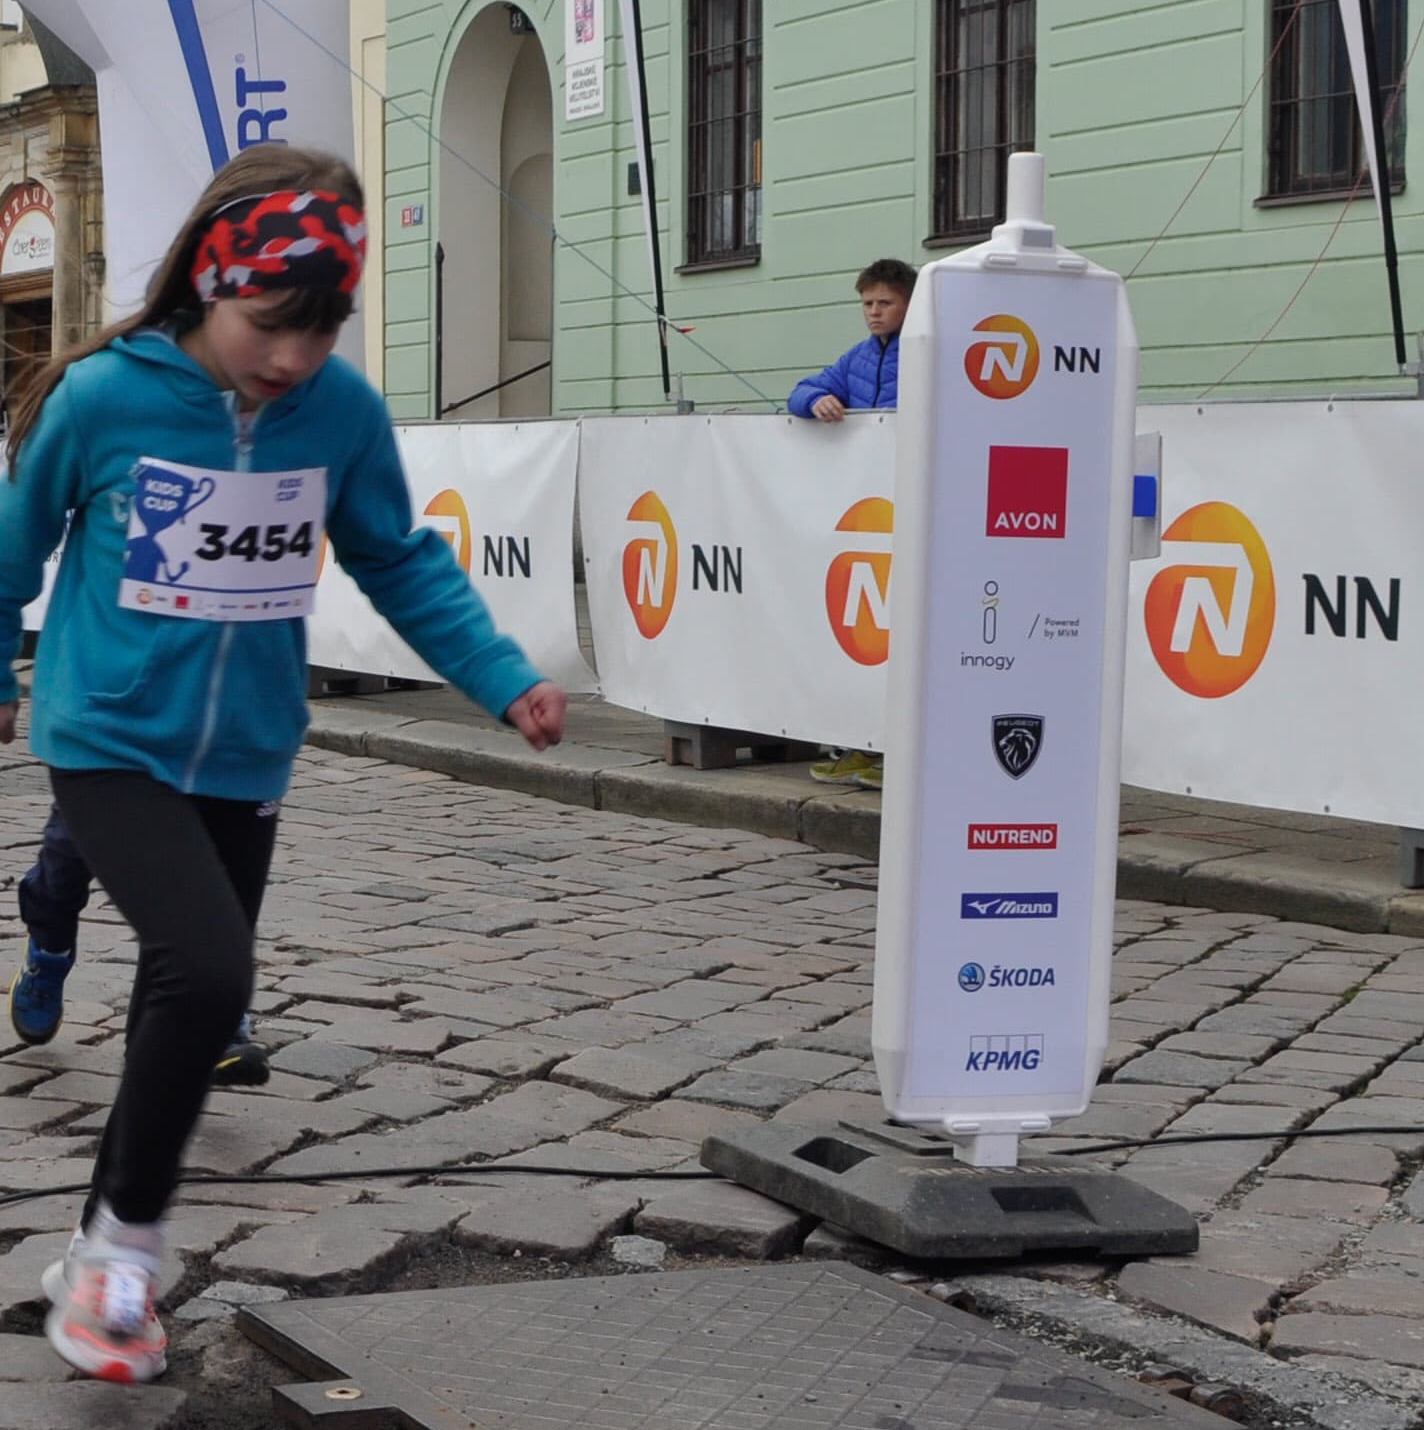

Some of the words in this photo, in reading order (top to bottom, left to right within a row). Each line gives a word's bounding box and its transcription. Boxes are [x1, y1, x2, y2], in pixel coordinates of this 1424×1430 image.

[1053, 344, 1101, 374] NN
[144, 479, 185, 498] KIDS
[143, 495, 179, 512] CUP
[994, 511, 1058, 531] AVON
[195, 521, 315, 563] 3454
[482, 534, 532, 579] NN
[691, 543, 744, 595] NN
[1302, 573, 1401, 642] NN
[960, 651, 1016, 671] innogy
[972, 828, 1054, 845] NUTREND
[987, 965, 1056, 988] ŠKODA
[965, 1048, 1041, 1072] KPMG
